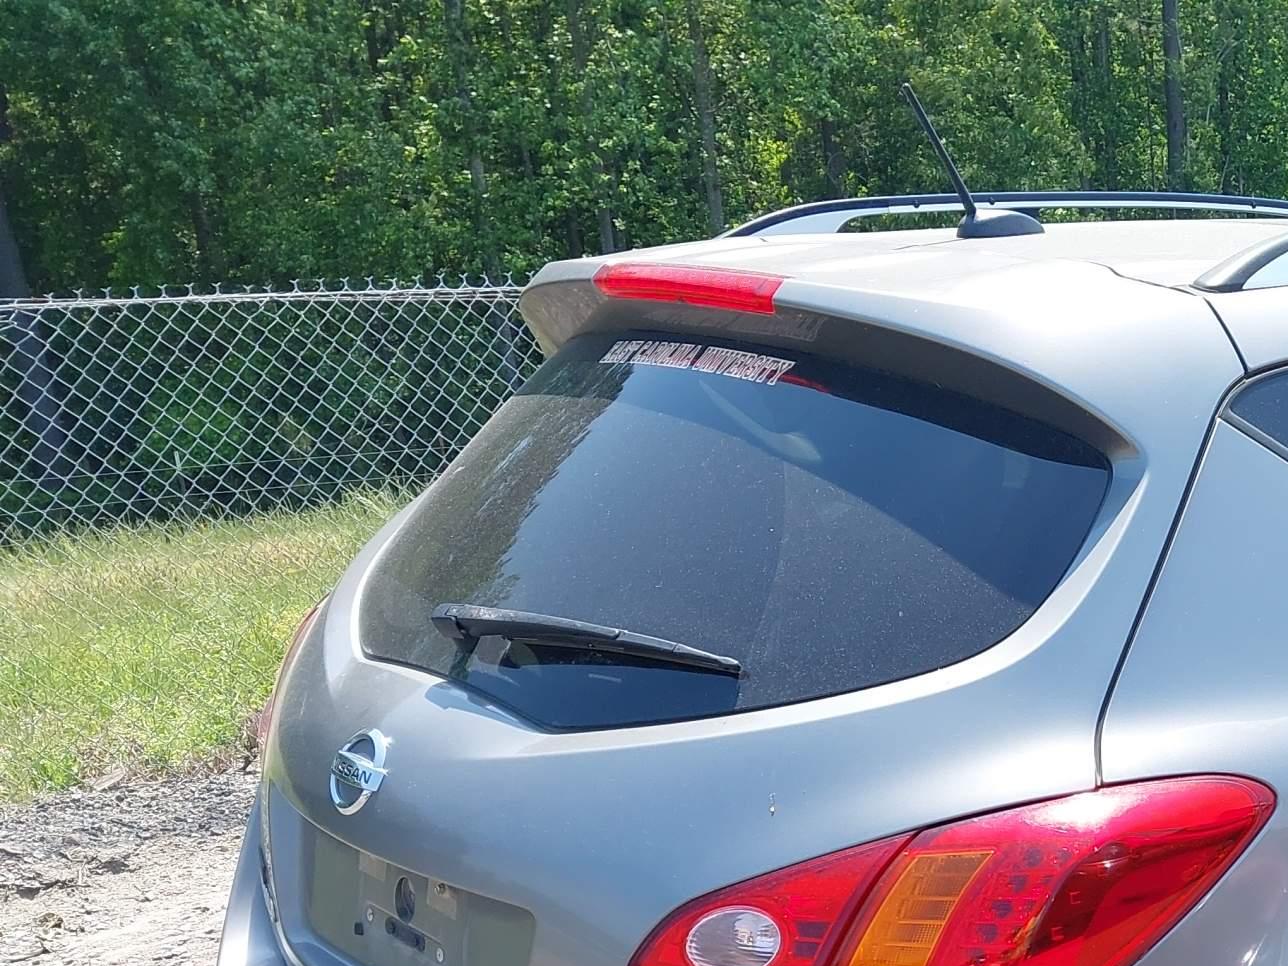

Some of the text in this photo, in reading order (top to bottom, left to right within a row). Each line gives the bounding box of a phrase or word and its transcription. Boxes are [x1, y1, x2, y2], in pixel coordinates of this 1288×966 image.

[599, 340, 797, 386] EAST CAROLINA UNIVERSITY
